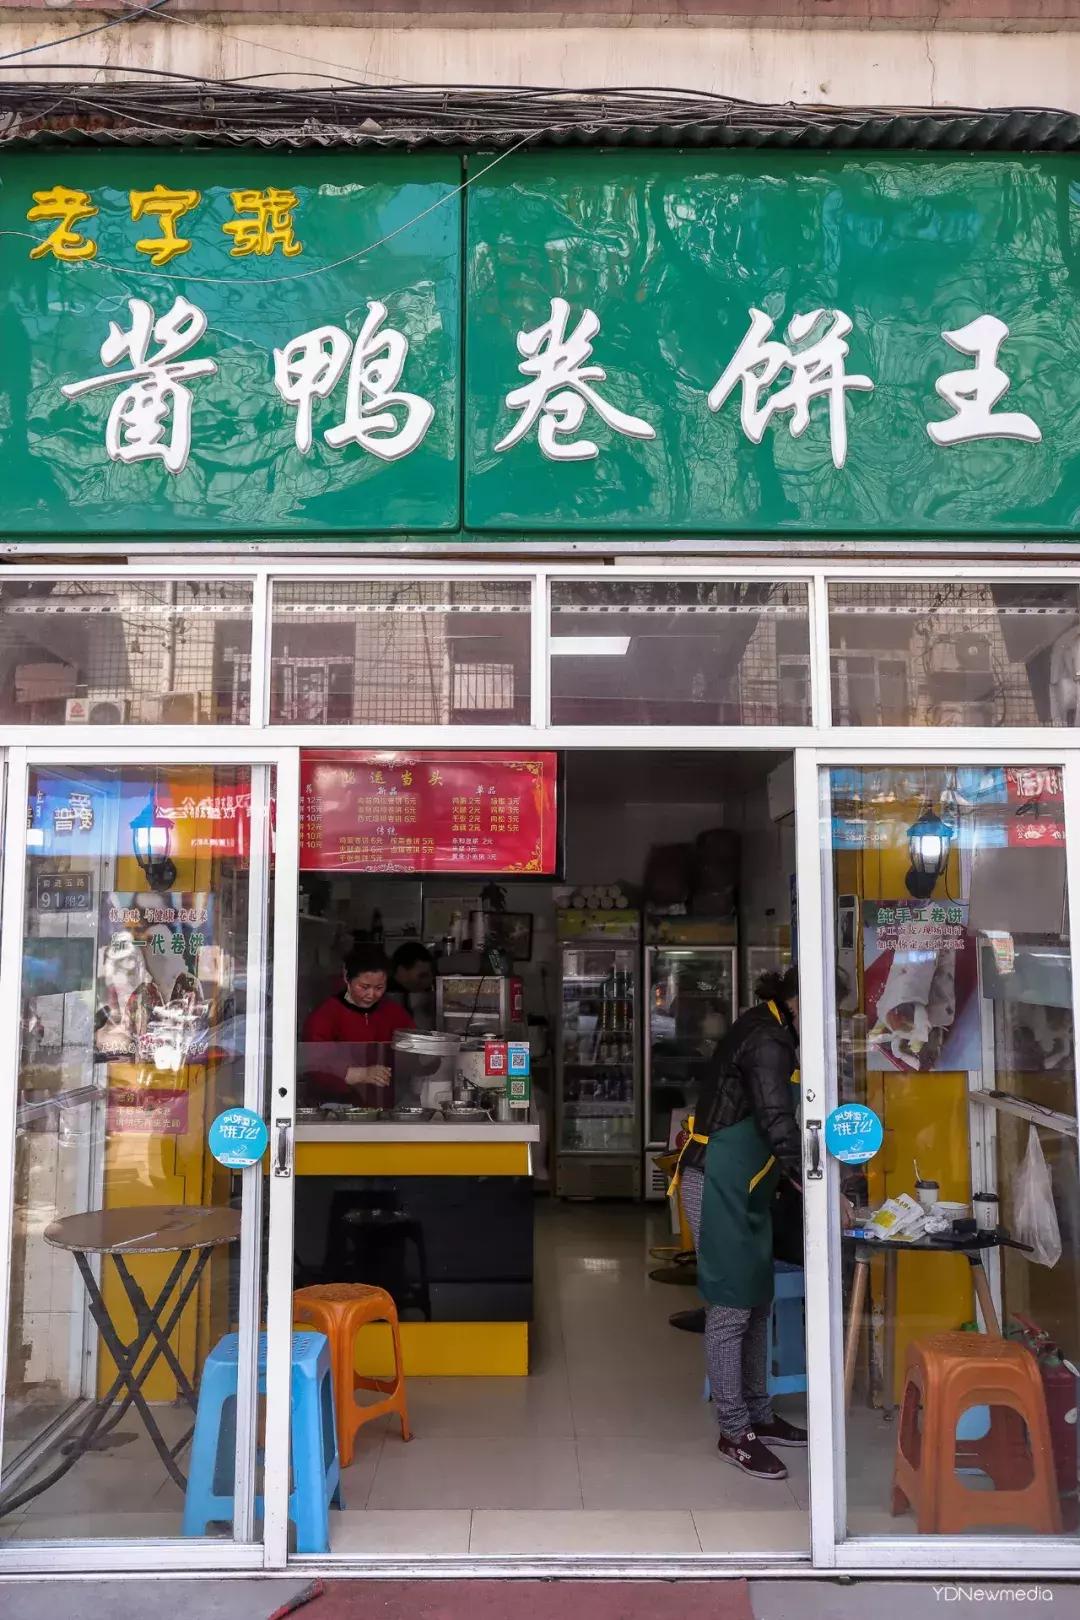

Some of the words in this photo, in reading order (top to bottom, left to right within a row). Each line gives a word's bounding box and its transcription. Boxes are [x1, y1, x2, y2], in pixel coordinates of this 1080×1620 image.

[27, 184, 303, 266] 老字號
[877, 906, 963, 925] 纯手工卷饼
